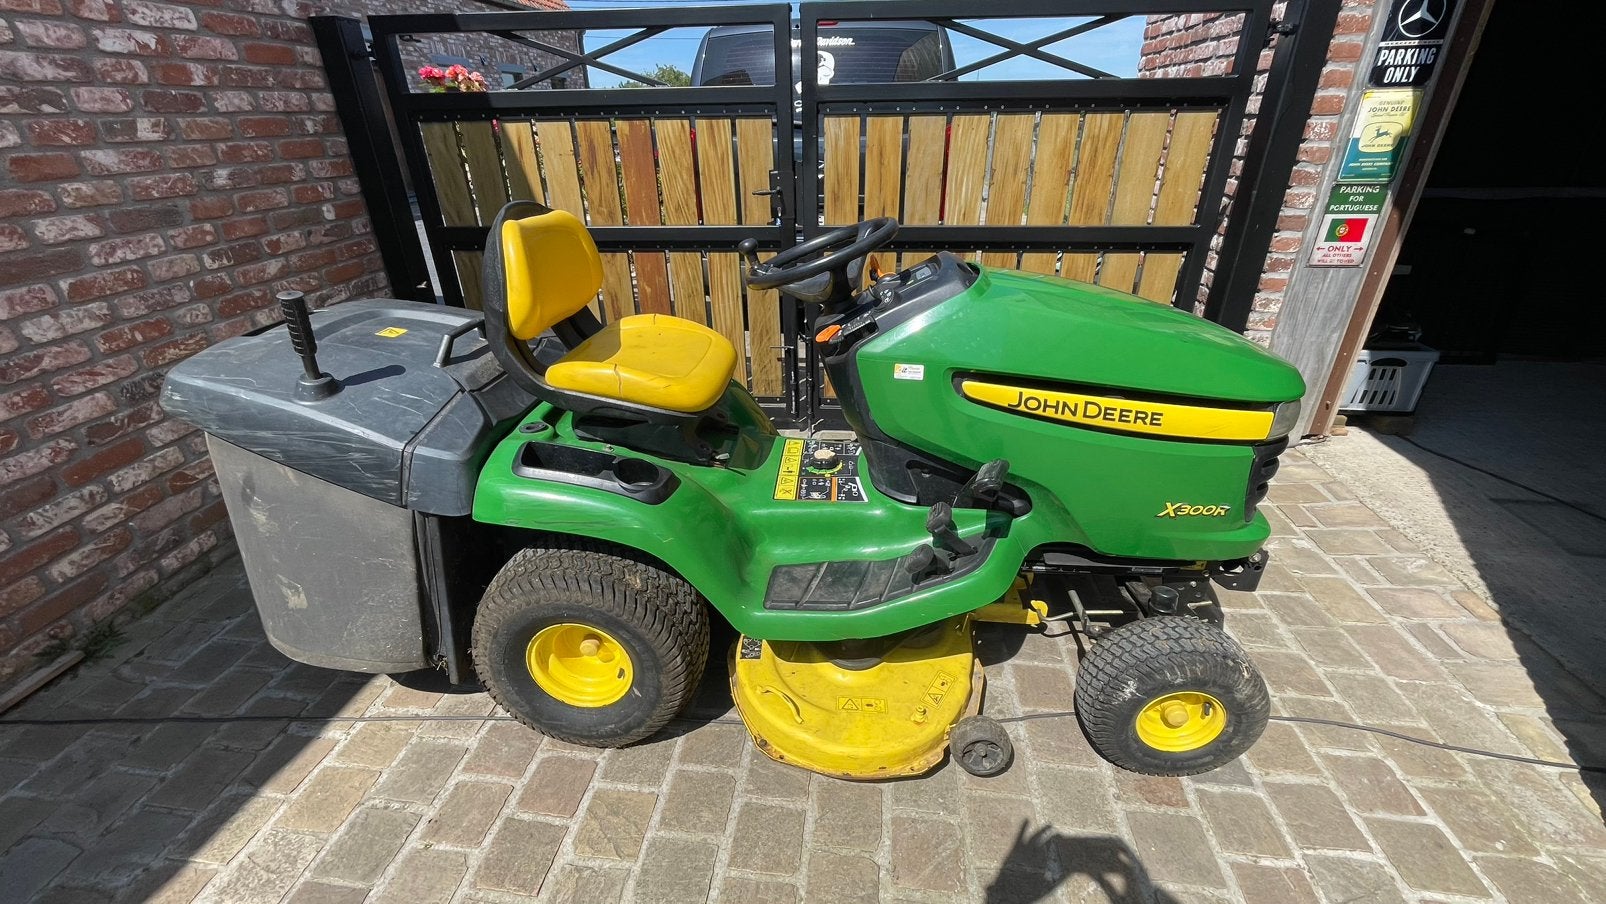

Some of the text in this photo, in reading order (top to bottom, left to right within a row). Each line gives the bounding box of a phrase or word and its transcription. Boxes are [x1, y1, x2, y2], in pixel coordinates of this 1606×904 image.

[1377, 48, 1437, 66] PARKING
[1383, 66, 1420, 83] ONLY
[1327, 245, 1353, 253] ONLY
[1007, 391, 1164, 426] JOHN DEERE
[1155, 502, 1231, 519] X300R
